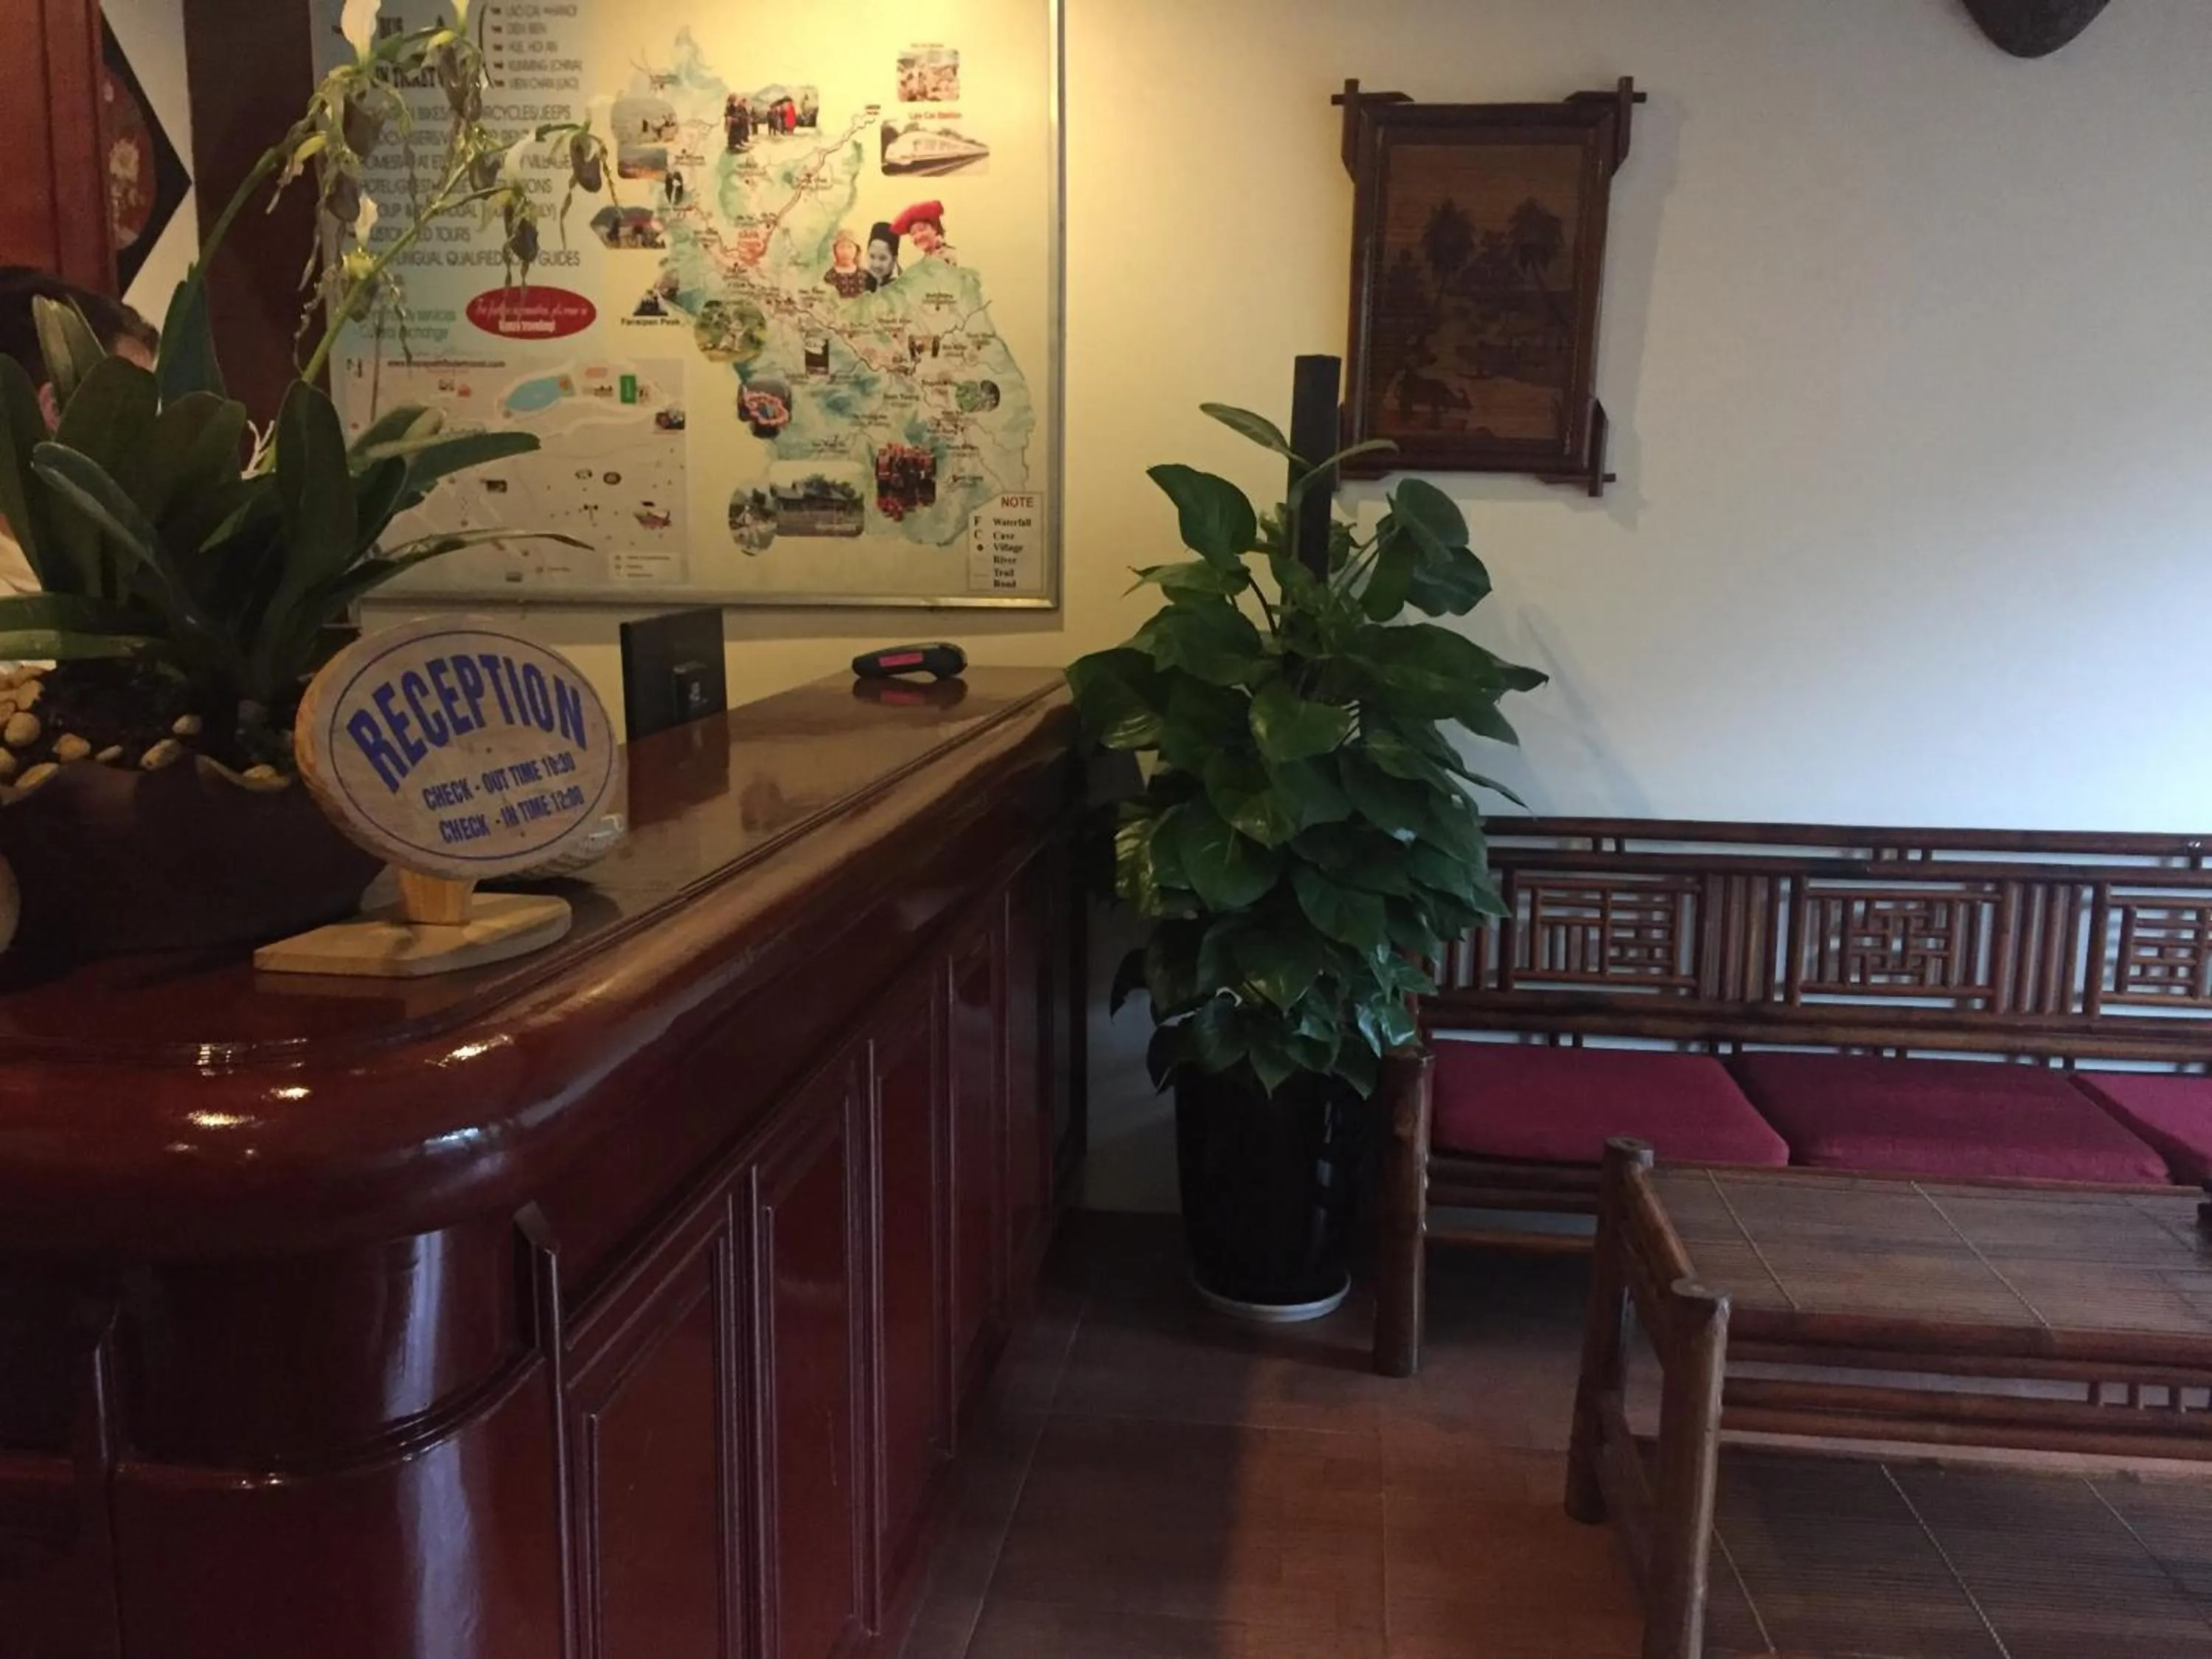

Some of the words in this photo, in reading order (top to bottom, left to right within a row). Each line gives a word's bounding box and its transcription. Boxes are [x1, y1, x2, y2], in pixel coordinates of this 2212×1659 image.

[538, 251, 580, 266] GUIDES
[1001, 496, 1034, 507] NOTE
[993, 518, 1032, 526] Waterfall
[993, 543, 1023, 554] Village
[347, 653, 586, 795] RECEPTION
[422, 778, 473, 811] CHECK
[481, 768, 509, 794] OUT
[509, 760, 543, 787] TIME
[439, 813, 491, 844] CHECK
[501, 804, 521, 829] IN
[518, 795, 552, 824] TIME
